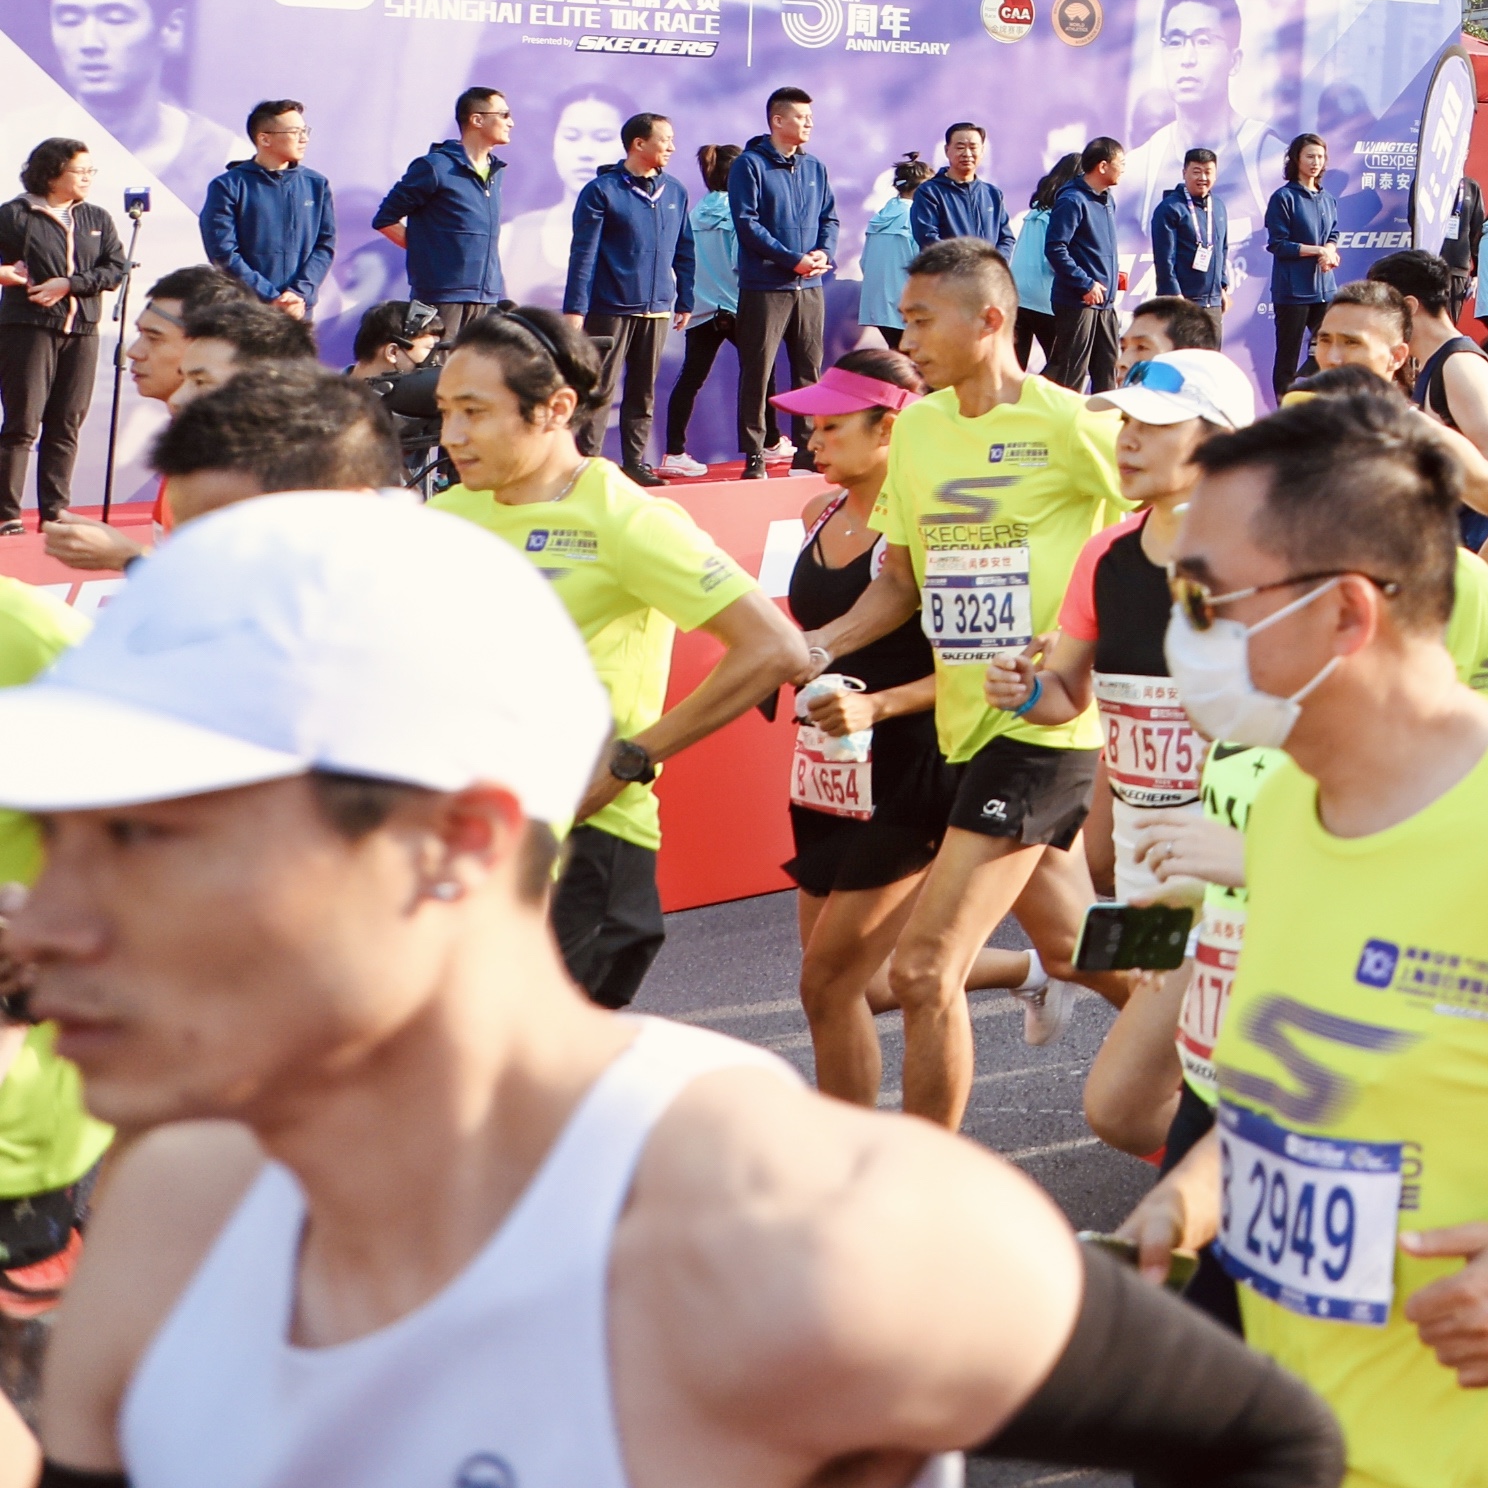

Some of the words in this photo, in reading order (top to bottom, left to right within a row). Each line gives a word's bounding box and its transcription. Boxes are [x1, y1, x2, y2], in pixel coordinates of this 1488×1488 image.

[530, 4, 600, 28] ELITE
[610, 10, 648, 31] 10K
[654, 12, 720, 34] RACE
[846, 4, 910, 38] 周年
[1001, 7, 1031, 20] CAA
[522, 35, 560, 46] Presented
[562, 37, 573, 48] by
[577, 35, 718, 57] SKECHERS
[846, 39, 950, 55] ANNIVERSARY
[1354, 141, 1417, 154] WINGTEC
[1361, 173, 1411, 190] 闻泰安
[1339, 231, 1412, 248] ECHER
[931, 592, 944, 633] B
[955, 592, 1015, 634] 3234
[1108, 718, 1119, 763] B
[1130, 725, 1193, 773] 1575
[798, 758, 806, 796] B
[812, 766, 859, 804] 1654
[1245, 1159, 1356, 1282] 2949
